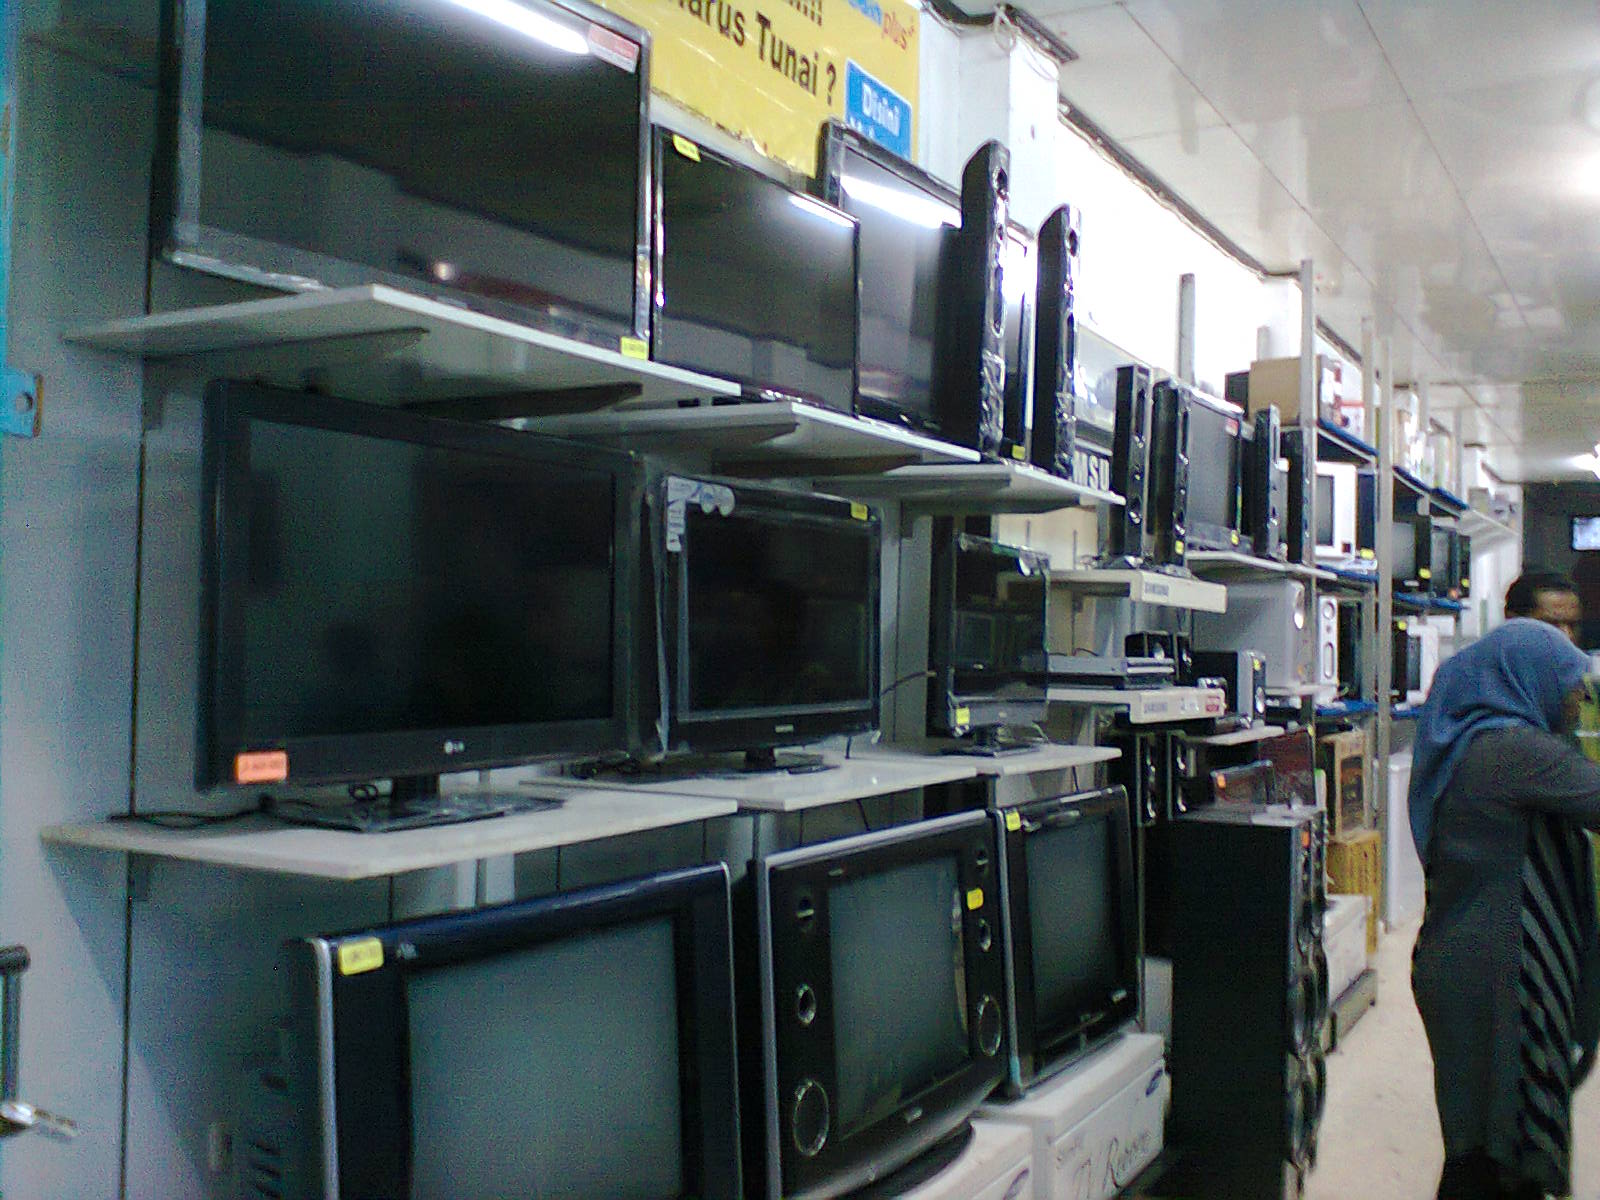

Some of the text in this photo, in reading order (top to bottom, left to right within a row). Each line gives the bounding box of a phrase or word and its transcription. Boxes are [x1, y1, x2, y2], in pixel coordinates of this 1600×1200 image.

[678, 0, 745, 47] arus
[756, 10, 819, 97] Tunai
[825, 60, 837, 106] ?
